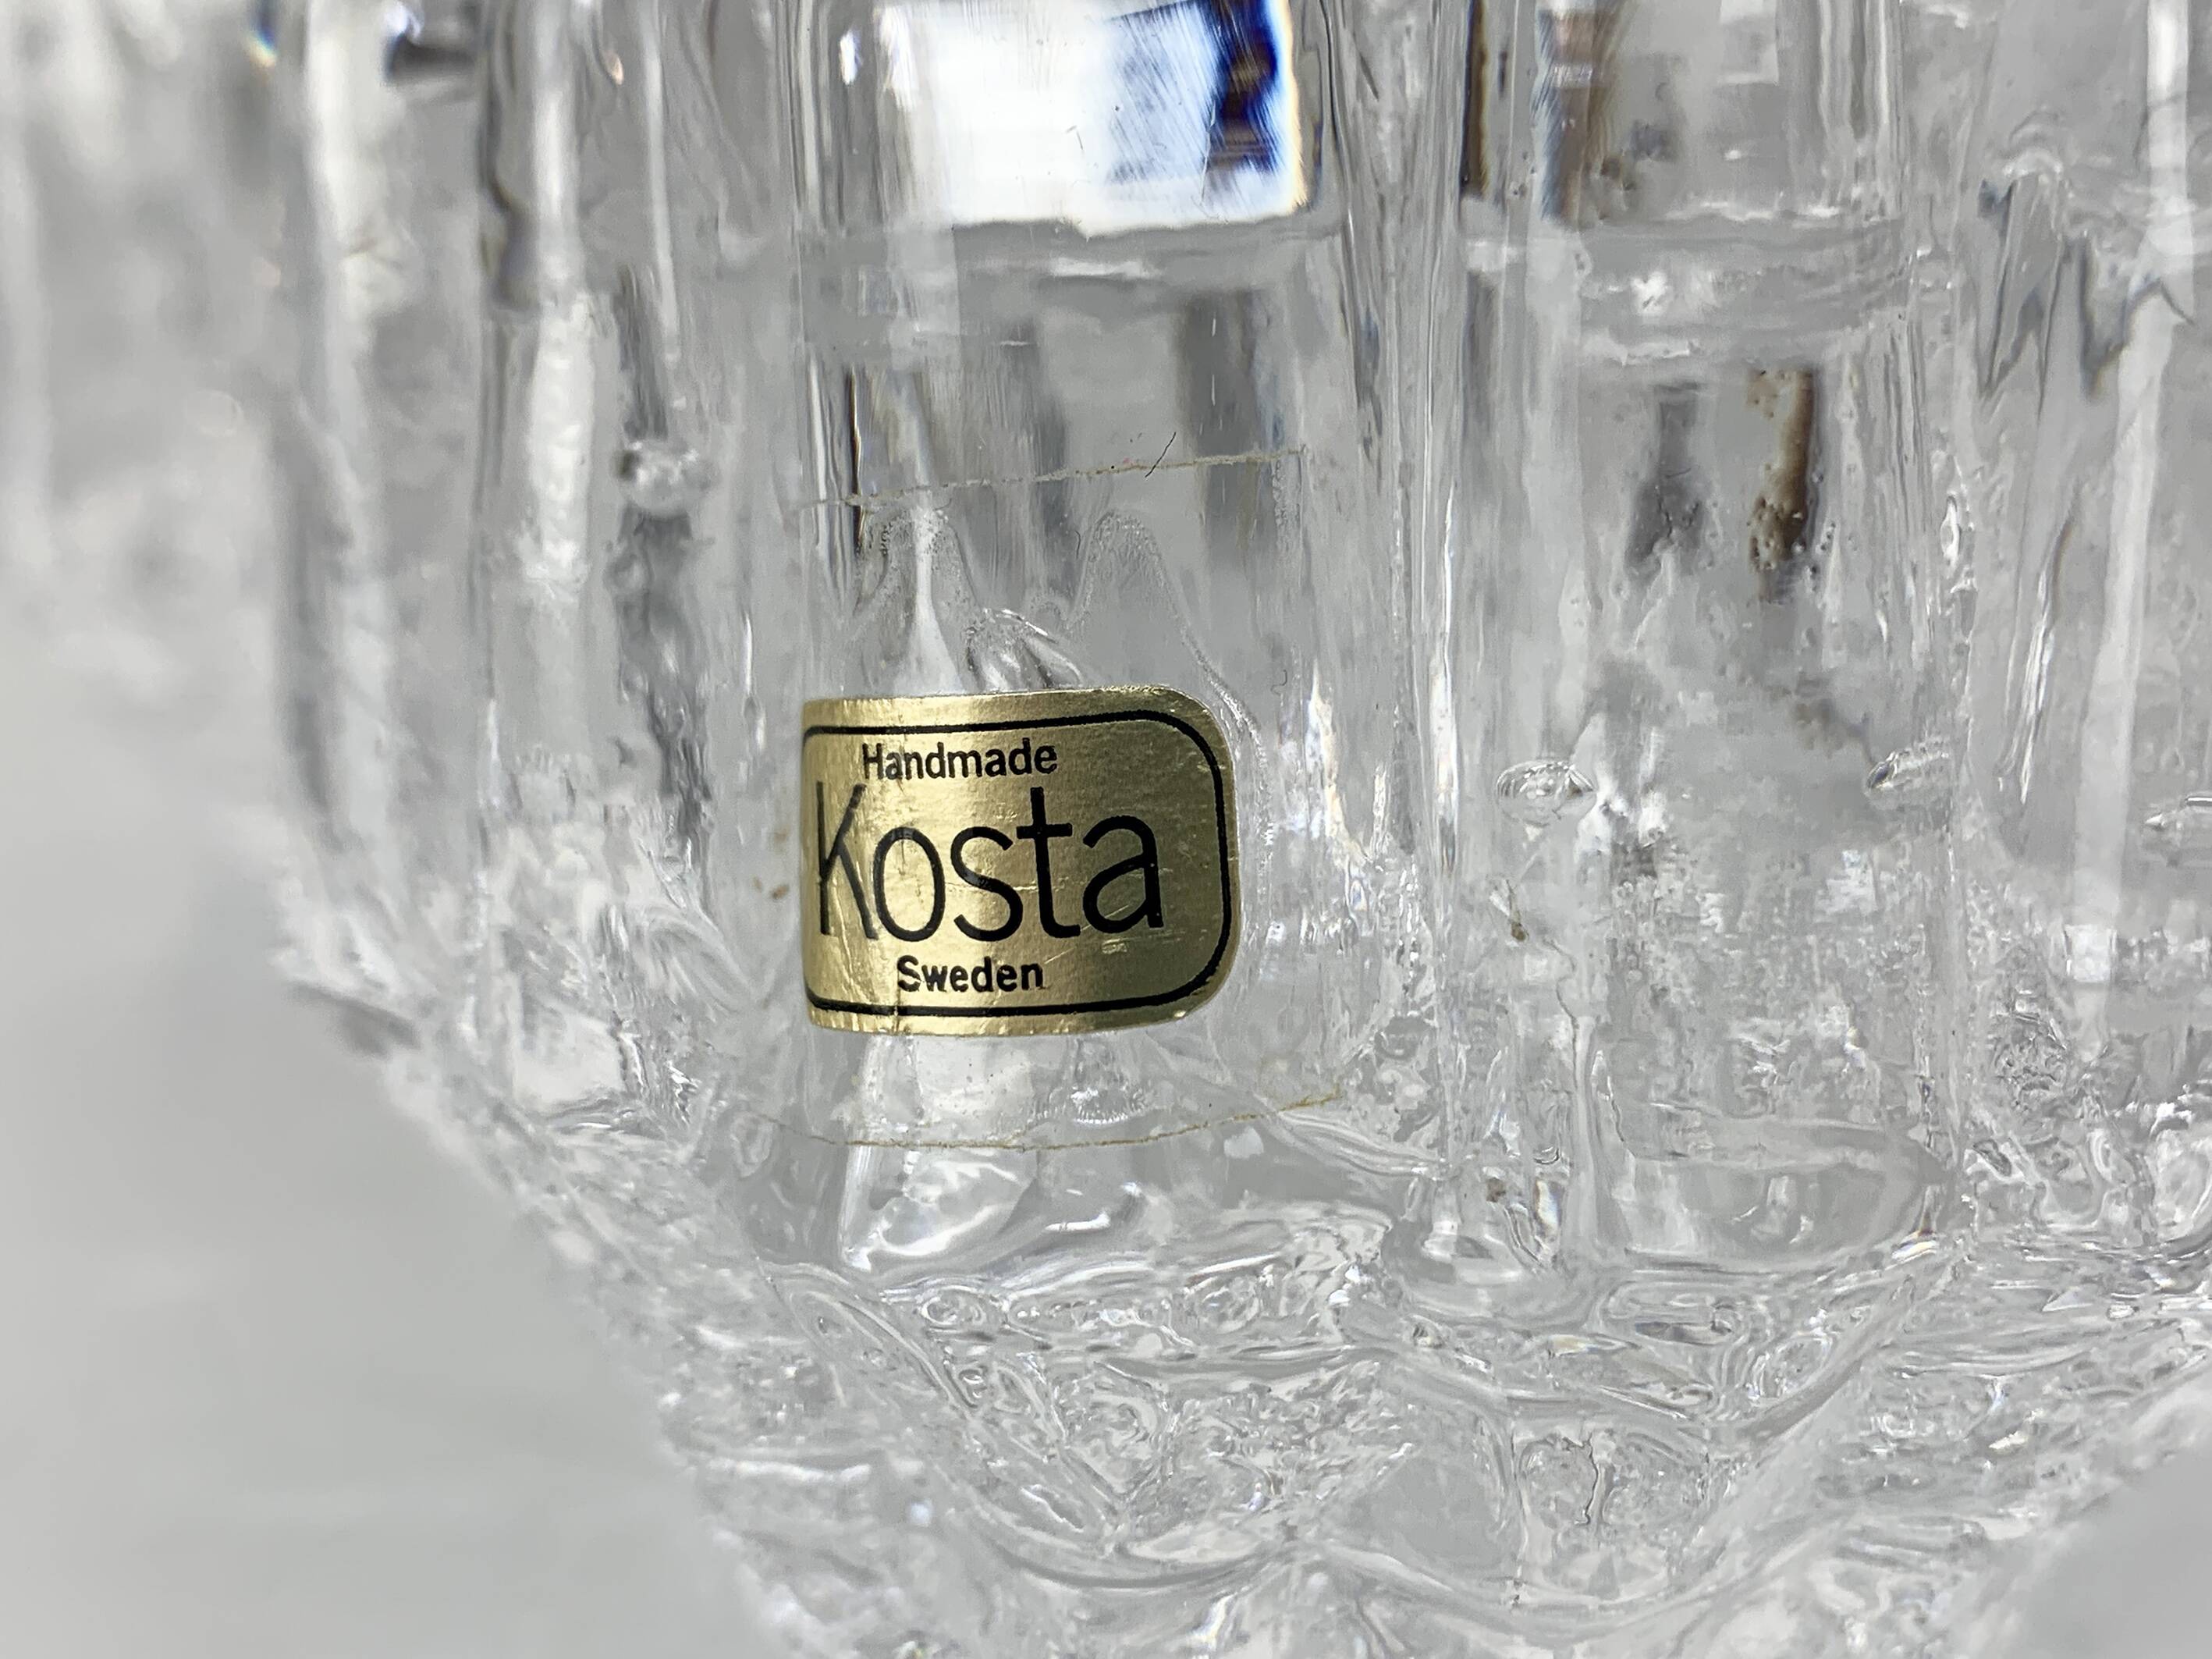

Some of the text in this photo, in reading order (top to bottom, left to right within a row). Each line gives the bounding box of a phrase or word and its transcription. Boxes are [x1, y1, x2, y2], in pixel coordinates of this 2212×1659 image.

[862, 737, 1058, 780] Handmade
[815, 780, 1165, 942] Kosta
[897, 954, 1044, 993] Sweden
